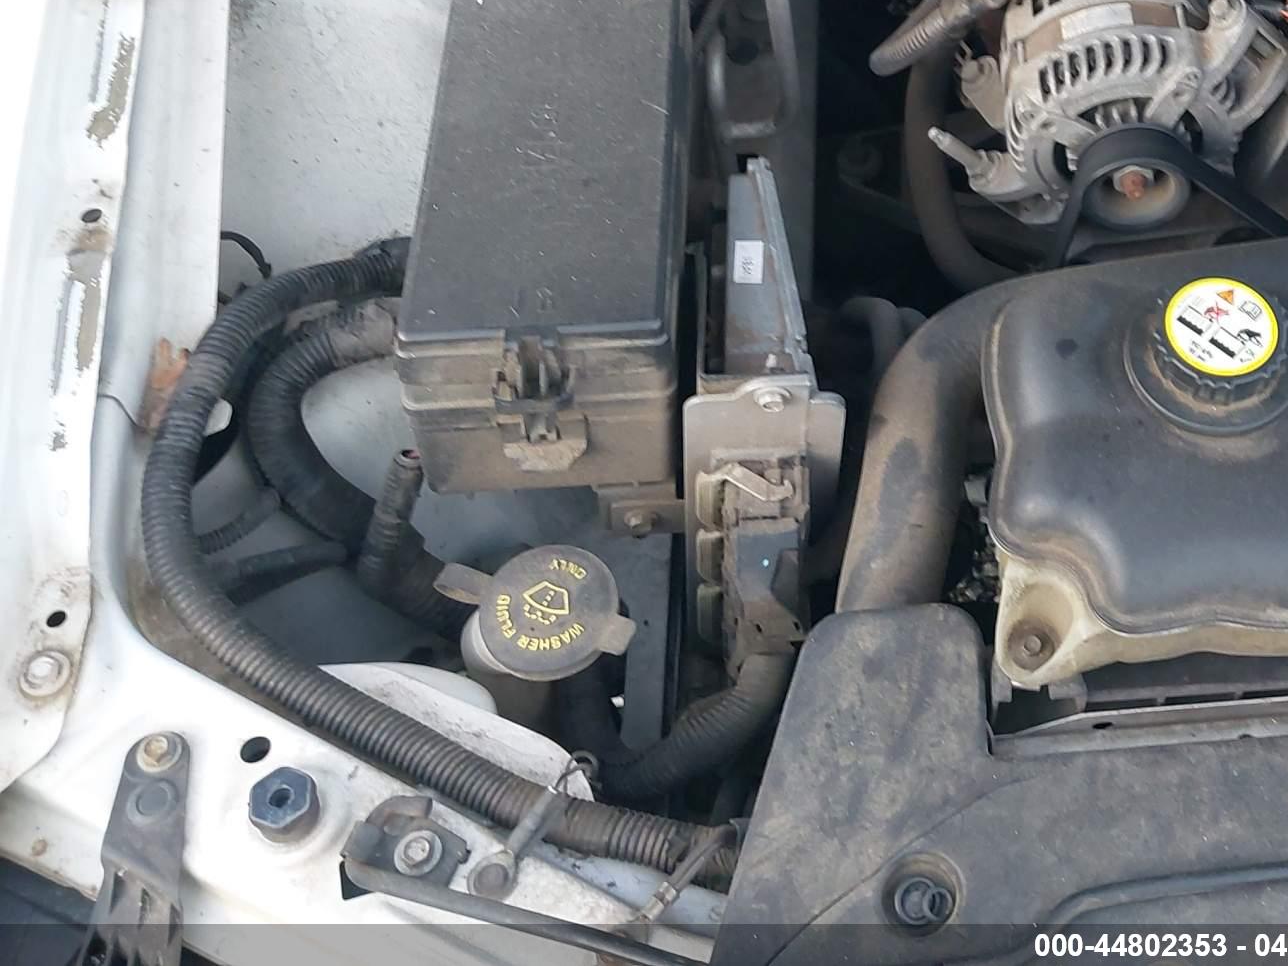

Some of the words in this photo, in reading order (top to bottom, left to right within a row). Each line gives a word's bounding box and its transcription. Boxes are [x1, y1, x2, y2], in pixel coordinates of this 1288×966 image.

[549, 558, 587, 580] ONLY
[495, 594, 516, 639] FLUID
[517, 622, 585, 651] WASHER
